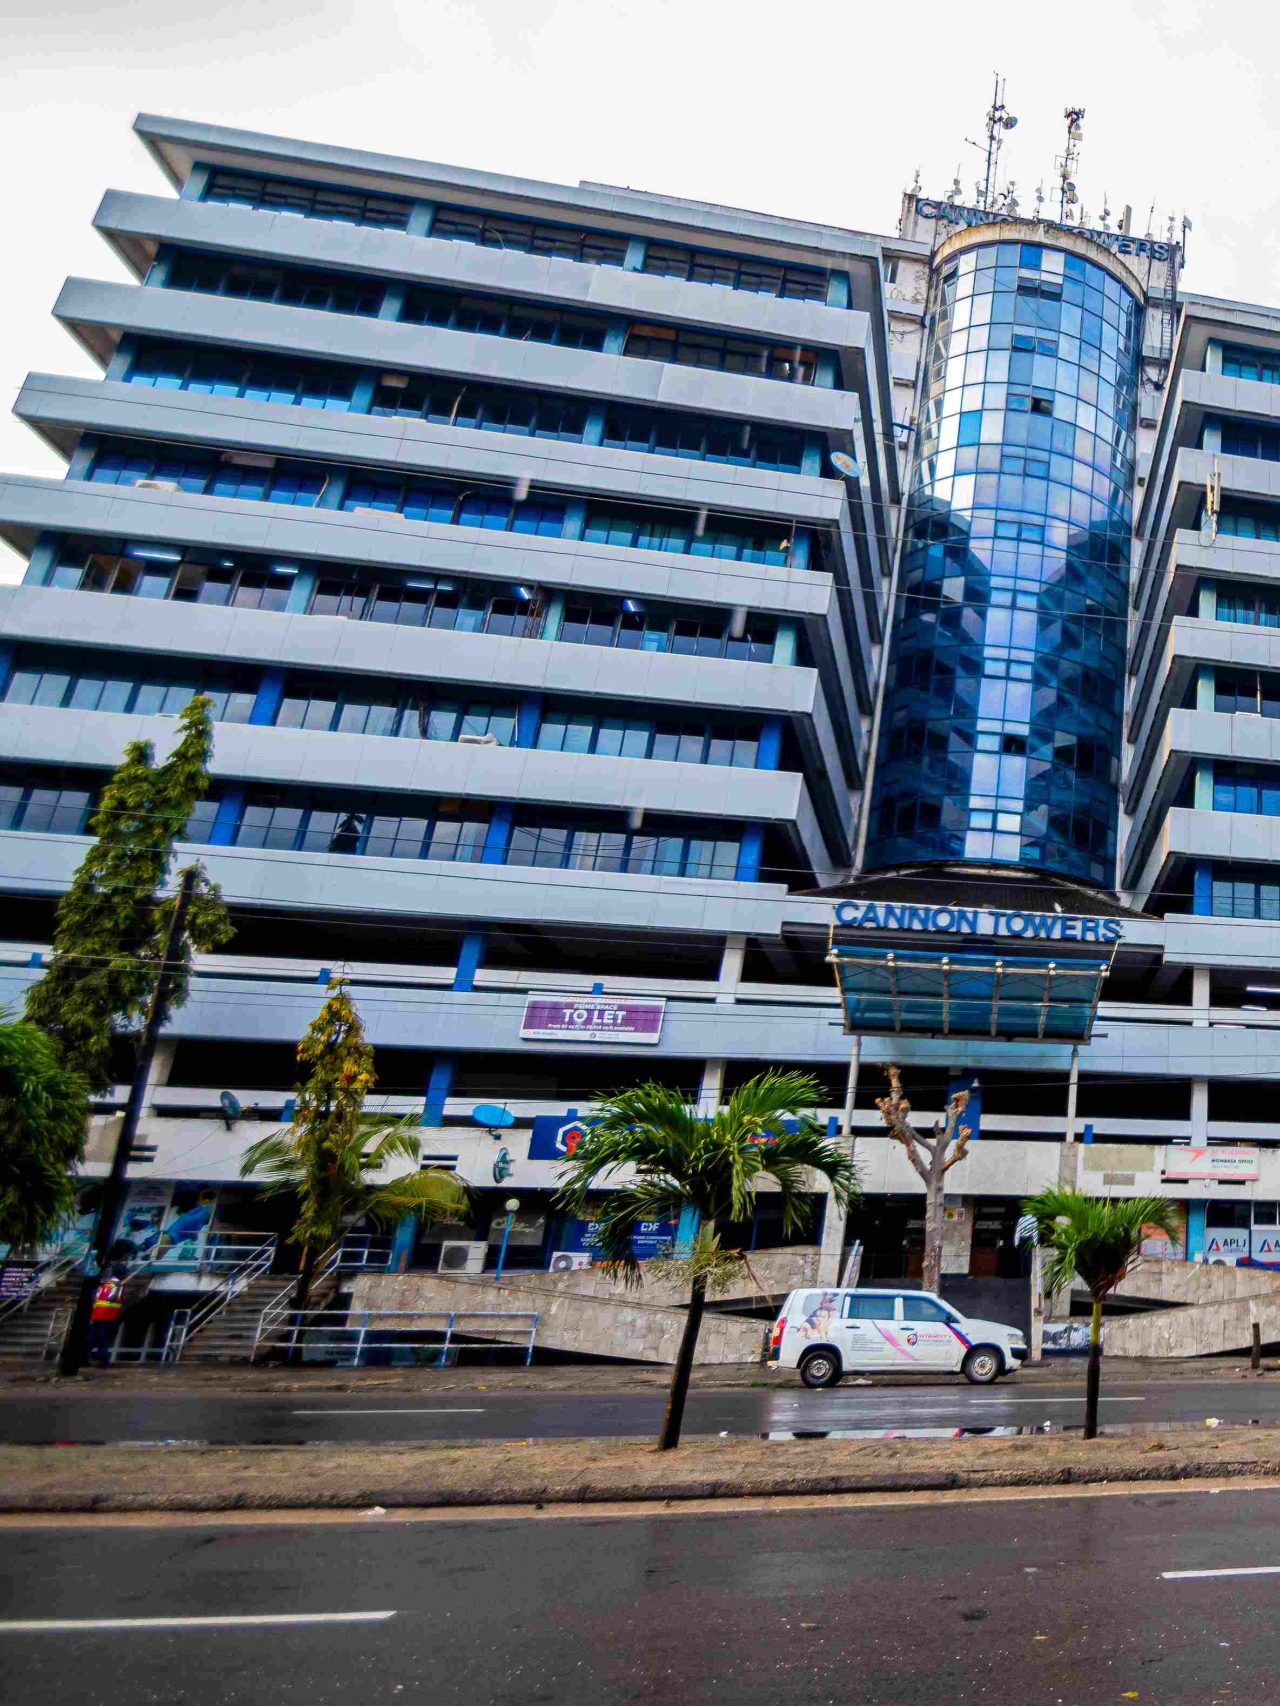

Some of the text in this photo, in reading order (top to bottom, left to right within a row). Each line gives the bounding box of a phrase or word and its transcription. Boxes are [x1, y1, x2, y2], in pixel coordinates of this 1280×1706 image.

[835, 900, 1122, 941] CANNON TOWERS
[563, 1009, 627, 1025] TO LET
[1223, 1238, 1246, 1247] APLJ
